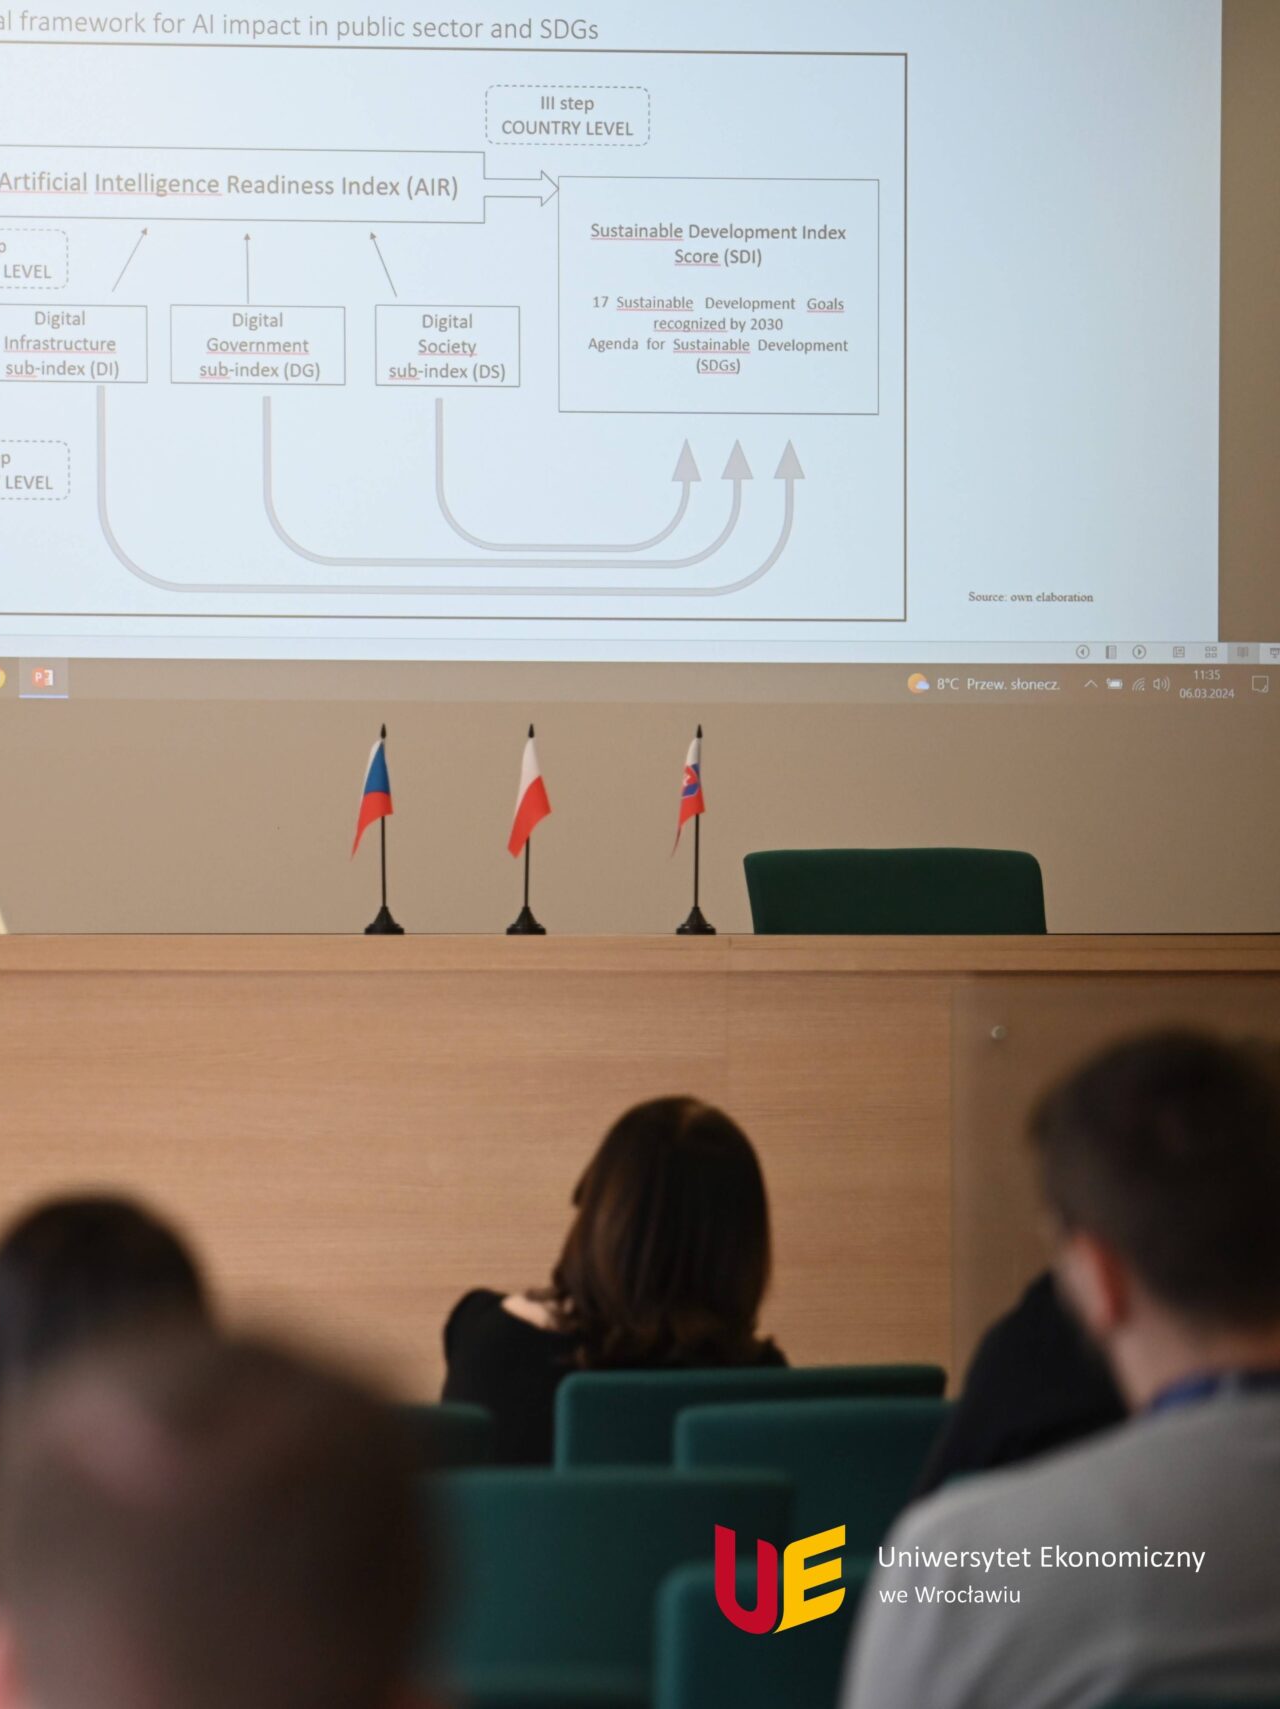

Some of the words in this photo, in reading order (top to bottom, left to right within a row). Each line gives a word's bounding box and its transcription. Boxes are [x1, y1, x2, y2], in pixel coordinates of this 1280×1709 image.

[20, 10, 145, 33] framework
[153, 12, 185, 34] for
[193, 14, 214, 35] AI
[222, 14, 301, 39] impact
[309, 15, 329, 36] in
[337, 15, 406, 41] public
[412, 18, 484, 39] sector
[490, 17, 532, 39] and
[540, 18, 599, 40] SDGs
[540, 96, 556, 111] III
[560, 97, 595, 115] step
[501, 119, 581, 137] COUNTRY
[586, 120, 634, 137] LEVEL
[95, 172, 220, 197] Intelligence
[227, 174, 335, 196] Readiness
[342, 175, 401, 197] Index
[407, 175, 459, 201] (AIR)
[591, 222, 684, 240] Sustainable
[688, 223, 797, 243] Development
[802, 224, 847, 241] Index
[674, 249, 719, 265] Score
[724, 248, 763, 268] (SDI)
[4, 263, 52, 279] LEVEL
[593, 296, 609, 309] 17
[616, 296, 694, 310] Sustainable
[705, 297, 796, 314] Development
[807, 297, 845, 312] Goals
[34, 310, 86, 330] Digital
[232, 312, 284, 331] Digital
[422, 313, 473, 333] Digital
[653, 317, 727, 335] recognized
[730, 318, 747, 335] by
[750, 318, 784, 331] 2030
[4, 335, 117, 352] Infrastructure
[206, 337, 310, 353] Government
[418, 338, 477, 357] Society
[588, 337, 639, 354] Agenda
[646, 337, 666, 351] for
[673, 338, 751, 353] Sustainable
[758, 339, 848, 356] Development
[5, 360, 85, 377] sub-index
[90, 361, 120, 380] (DI)
[200, 362, 280, 378] sub-index
[283, 362, 321, 382] (DG)
[389, 363, 468, 380] sub-index
[472, 363, 506, 383] (DS)
[696, 358, 741, 375] (SDGs)
[4, 475, 54, 490] LEVEL
[968, 591, 1008, 603] Source:
[1010, 593, 1033, 603] own
[1036, 591, 1094, 603] elaboration
[936, 677, 960, 691] 8°C
[967, 677, 1008, 692] Przew.
[1193, 669, 1221, 682] 11:35
[1179, 688, 1235, 700] 06.03.2024
